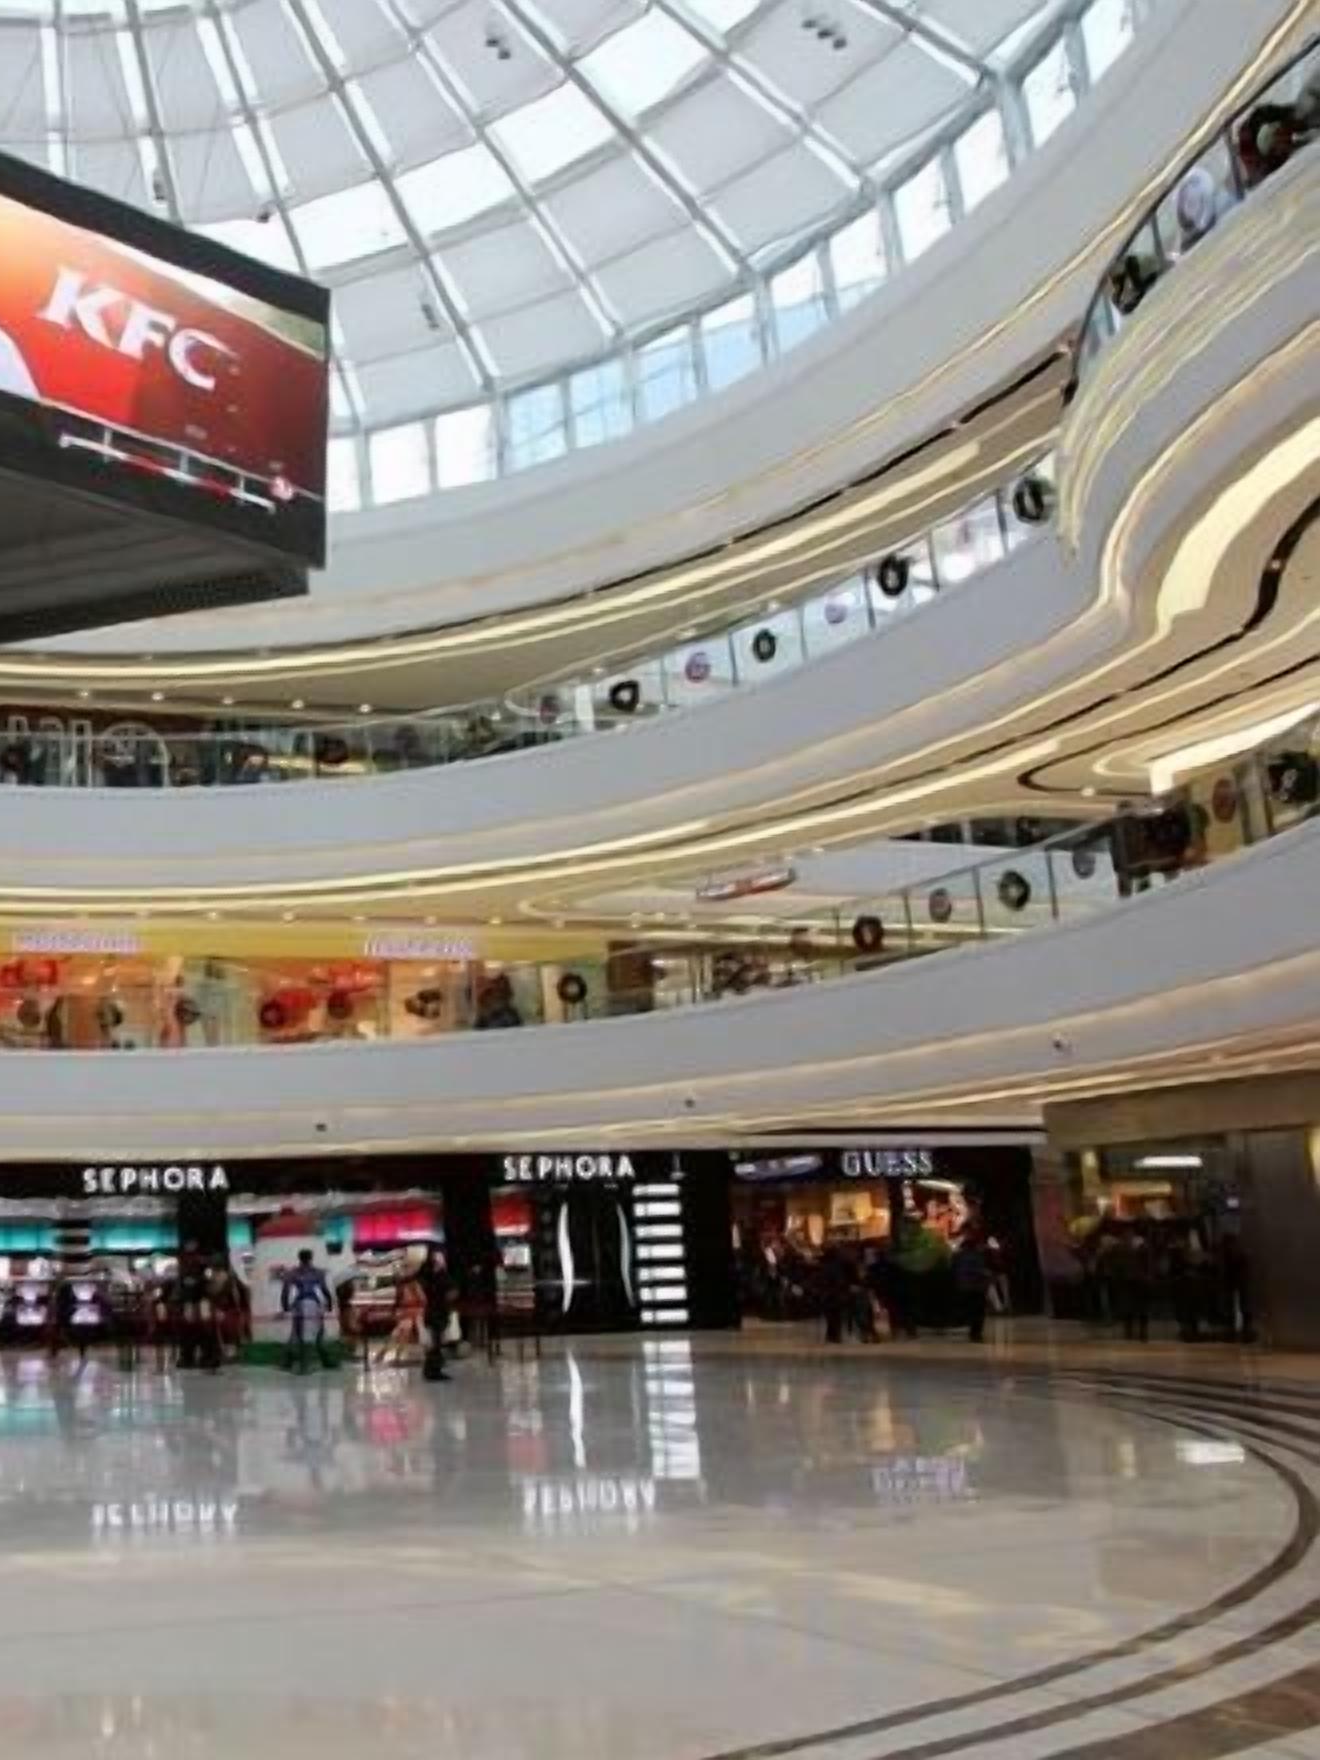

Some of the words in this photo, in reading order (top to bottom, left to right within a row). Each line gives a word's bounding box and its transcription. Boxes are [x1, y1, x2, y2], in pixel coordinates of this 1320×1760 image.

[36, 265, 238, 391] KFC
[503, 1154, 635, 1181] SEPHORA
[842, 1150, 933, 1177] GUESS
[83, 1166, 229, 1193] SEPHORA
